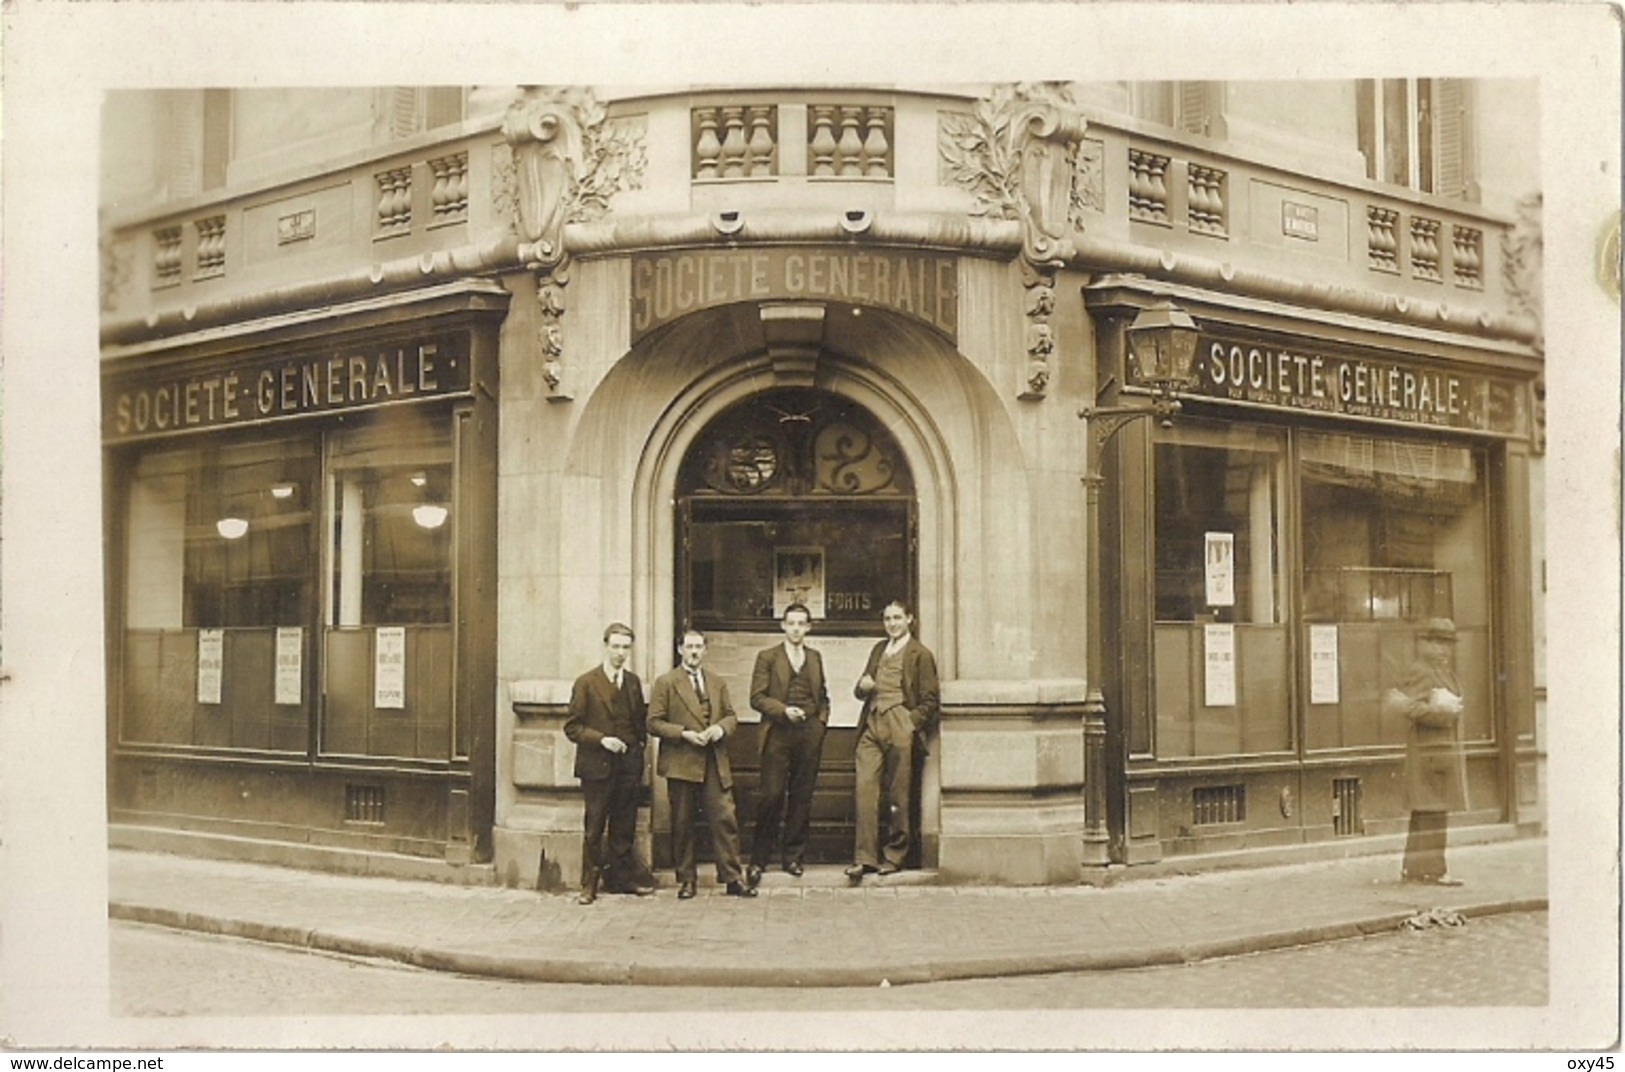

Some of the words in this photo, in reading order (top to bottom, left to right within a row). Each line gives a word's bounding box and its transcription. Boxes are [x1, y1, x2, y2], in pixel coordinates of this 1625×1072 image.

[785, 250, 957, 334] GÉNÉRALE
[1210, 342, 1325, 398] SOCIÉTÉ
[1339, 361, 1461, 414] GÉNÉRALE
[827, 592, 872, 610] FORTS
